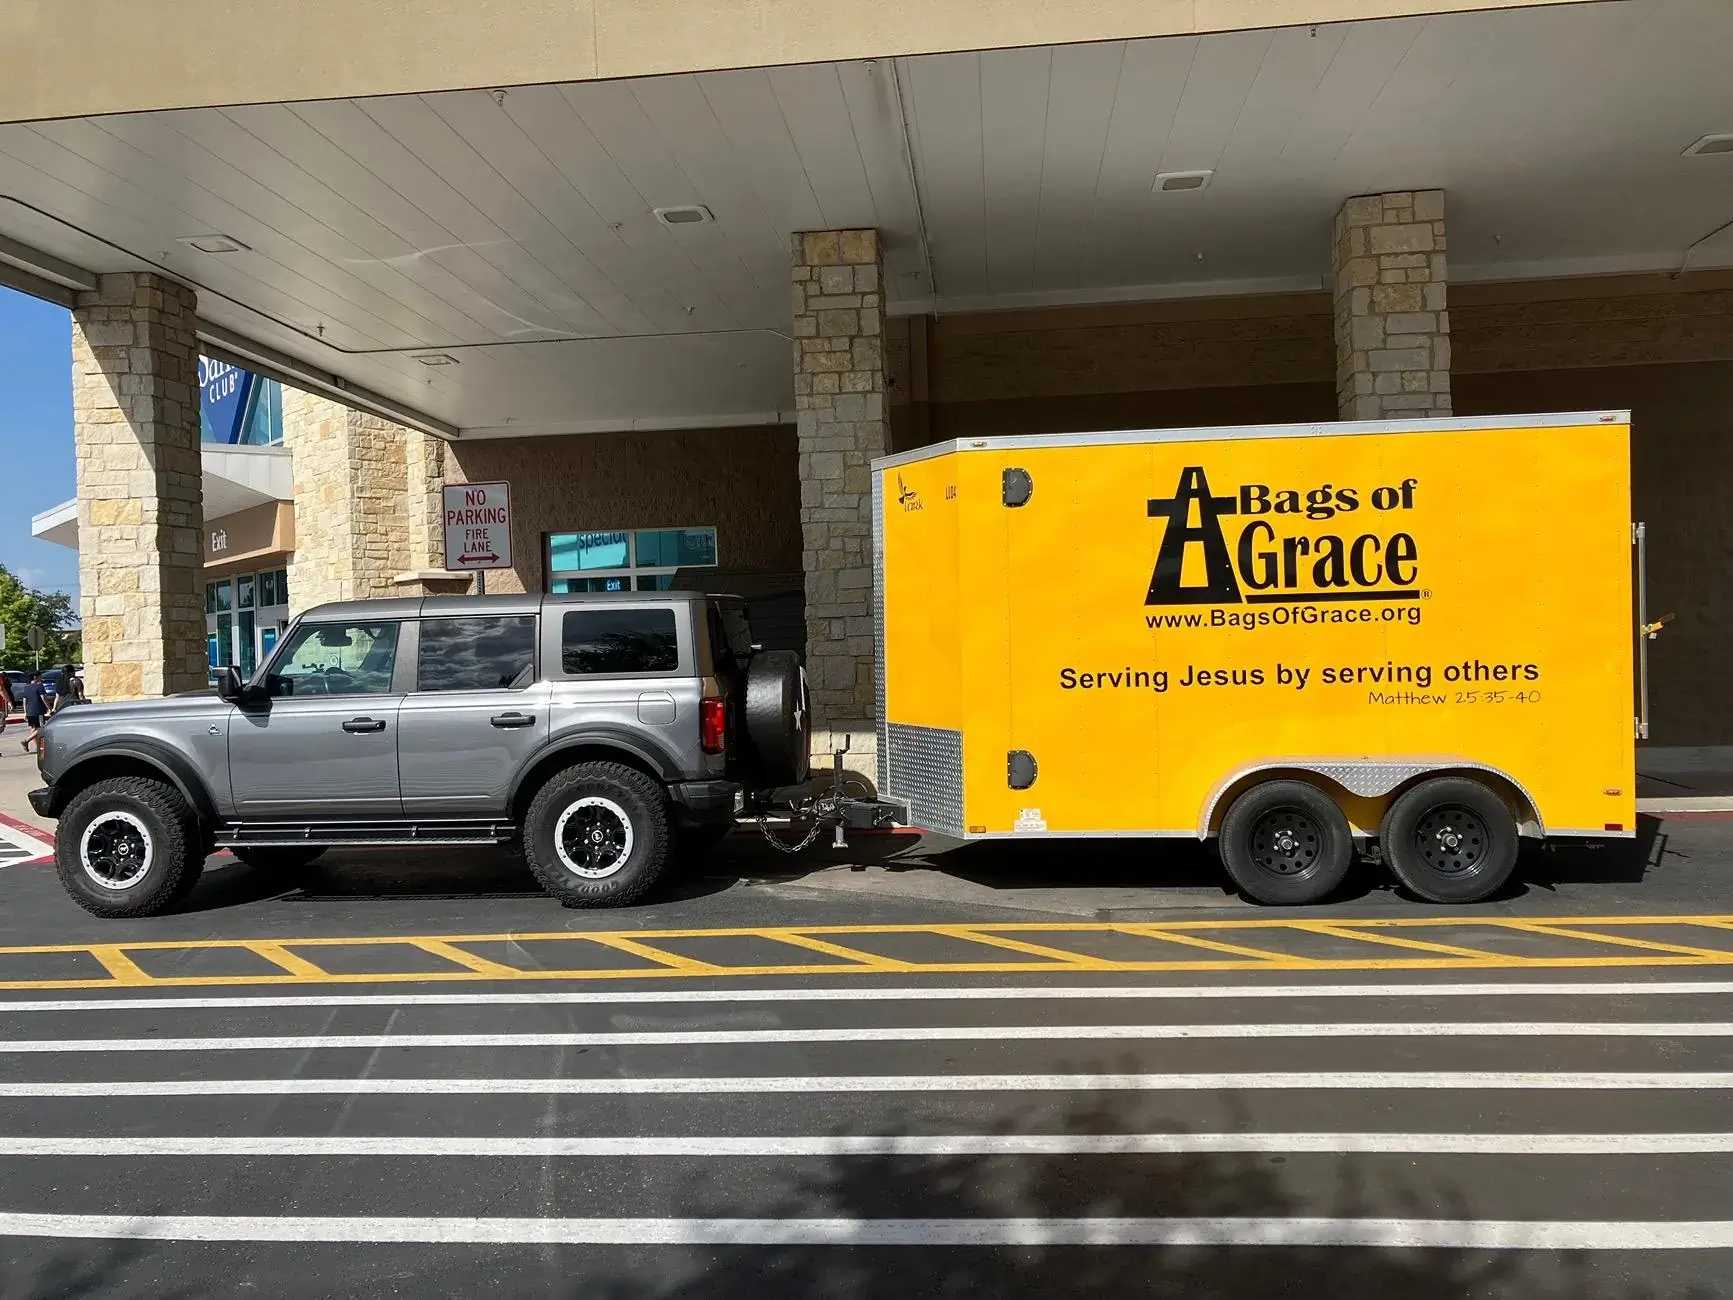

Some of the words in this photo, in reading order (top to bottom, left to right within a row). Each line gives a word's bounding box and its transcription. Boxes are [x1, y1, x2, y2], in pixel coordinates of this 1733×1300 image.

[209, 373, 235, 404] CLUB
[465, 489, 486, 506] NO
[1240, 484, 1360, 520] Bags
[1371, 478, 1418, 511] of
[447, 508, 506, 526] PARKING
[211, 529, 228, 552] Exit
[465, 528, 489, 540] FIRE
[463, 541, 492, 553] LANE
[1237, 520, 1418, 590] Grace
[606, 579, 621, 591] Exit
[1145, 605, 1421, 630] www.BagsOfGrace.org
[1060, 667, 1168, 692] Serving
[1179, 665, 1265, 687] Jesus
[1277, 664, 1310, 690] by
[1322, 661, 1431, 688] serving
[1444, 660, 1539, 681] others
[1368, 690, 1447, 705] Matthew
[1455, 690, 1541, 704] 25:35-40
